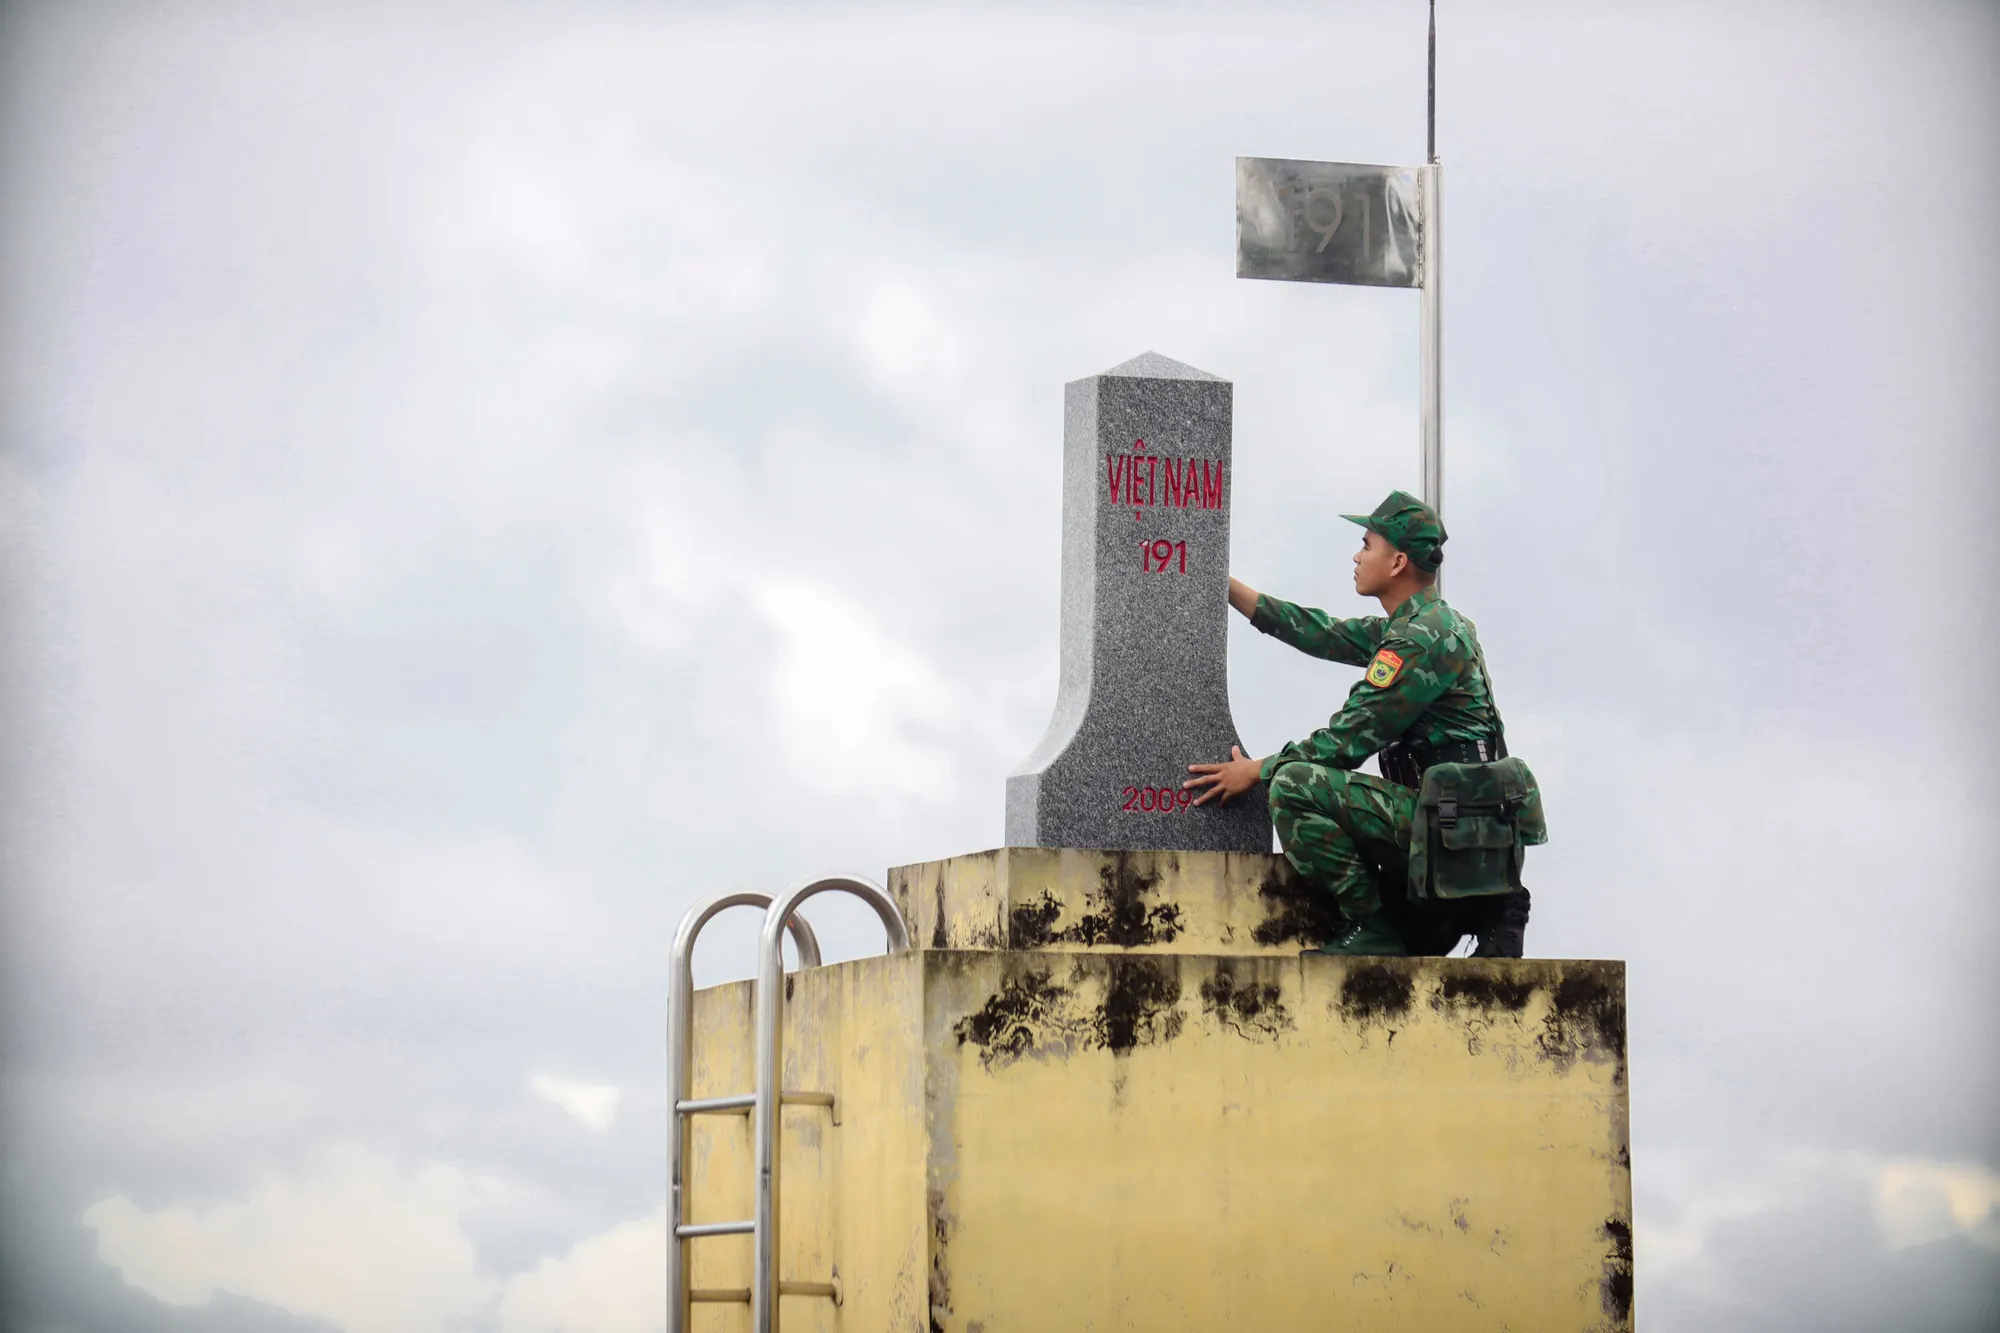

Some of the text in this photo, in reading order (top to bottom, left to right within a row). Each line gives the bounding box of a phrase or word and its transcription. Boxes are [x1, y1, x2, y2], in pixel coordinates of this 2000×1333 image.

[1278, 188, 1371, 263] 191
[1106, 438, 1223, 522] VIỆT NAM
[1139, 538, 1187, 575] 191
[1122, 785, 1193, 814] 2009
